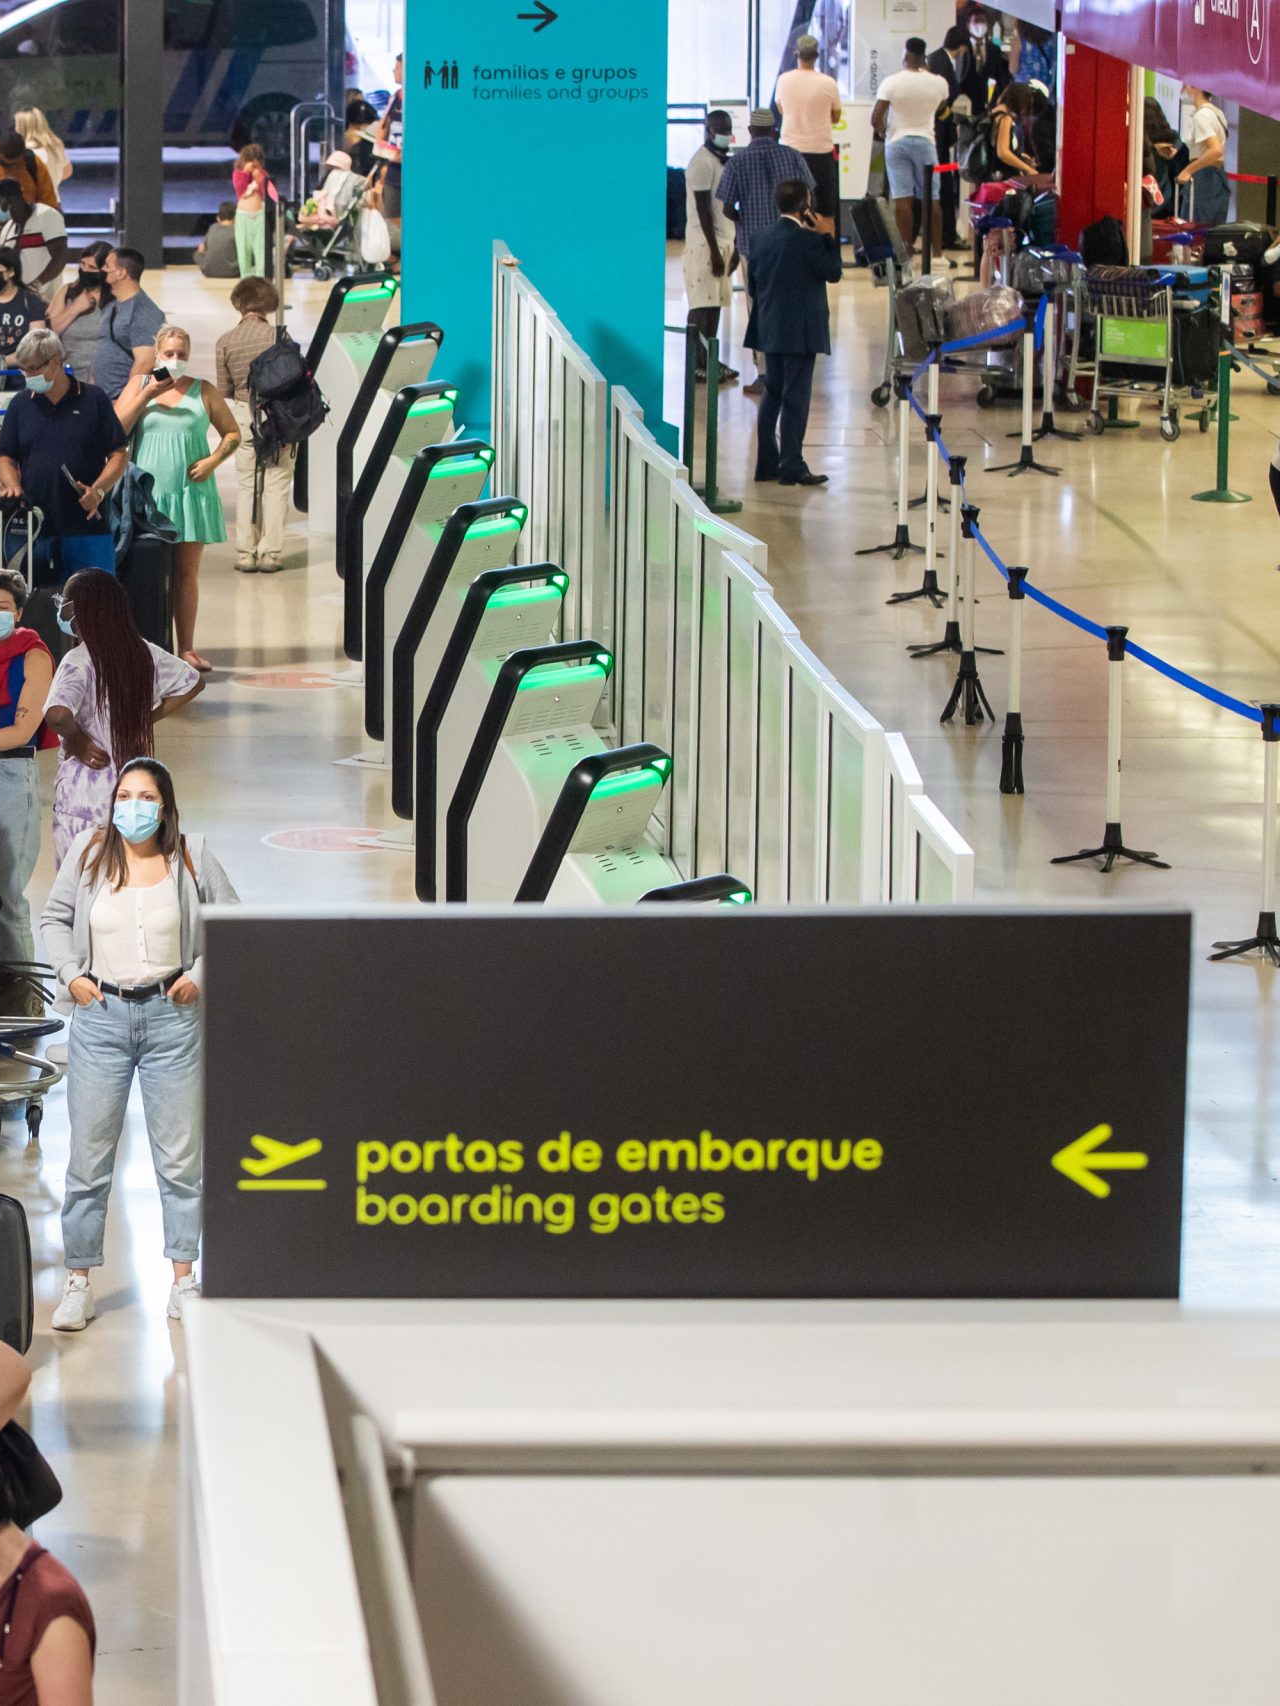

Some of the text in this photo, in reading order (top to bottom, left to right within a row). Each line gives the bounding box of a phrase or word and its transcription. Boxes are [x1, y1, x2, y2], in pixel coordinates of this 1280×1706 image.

[555, 68, 566, 80] e
[571, 67, 637, 84] grupos
[472, 85, 649, 102] families and groups
[356, 1129, 884, 1184] portas de embarque
[356, 1183, 726, 1235] boarding gates
